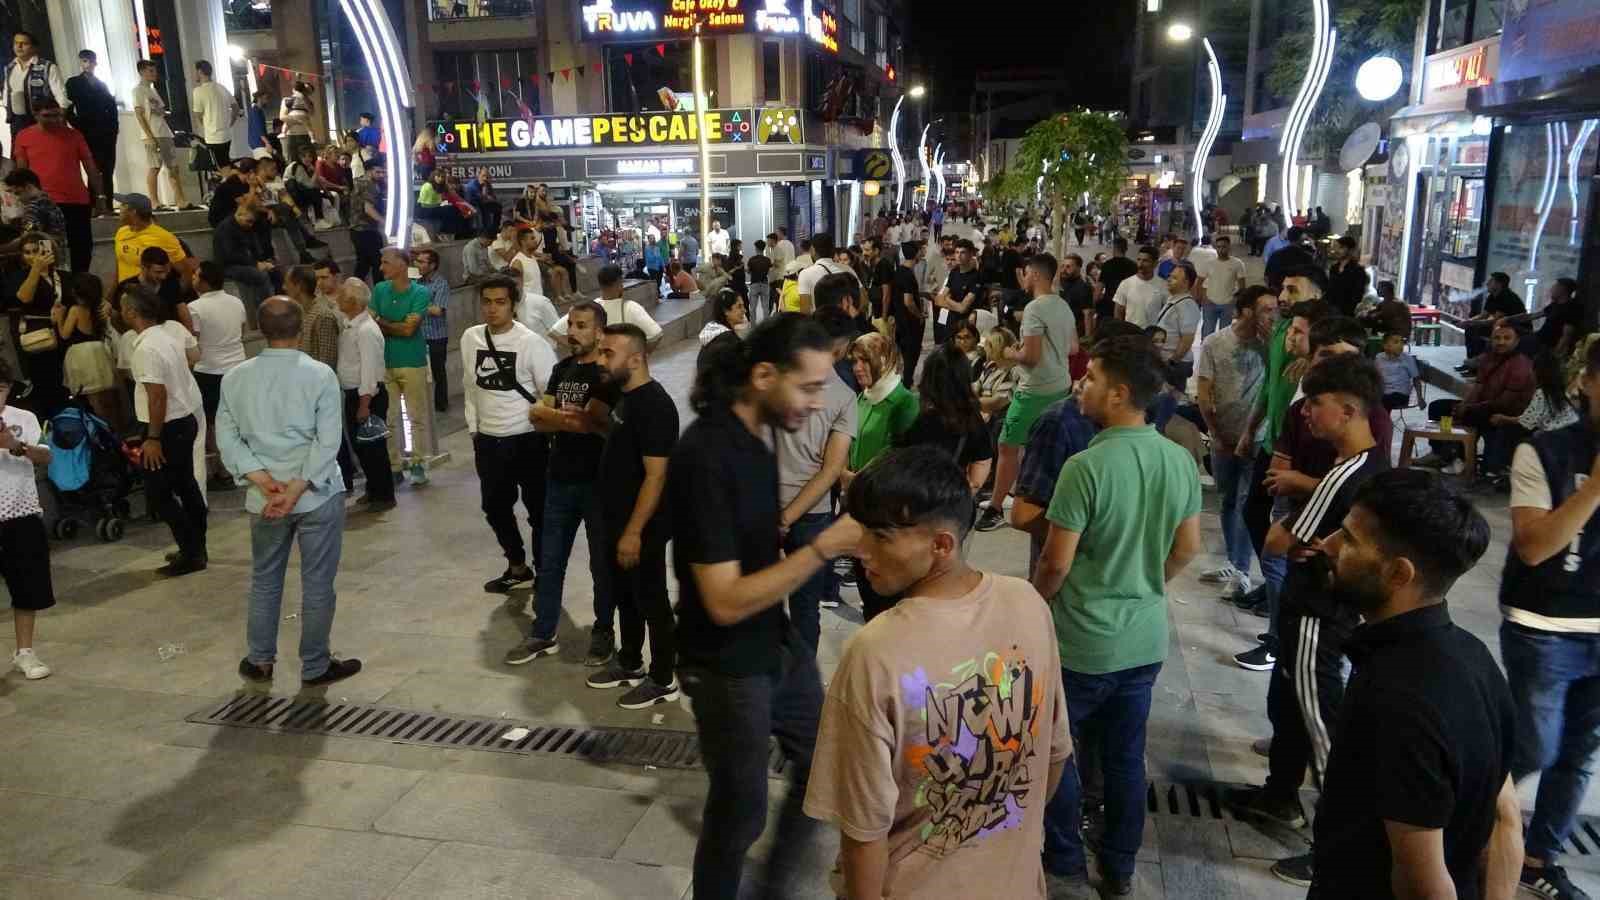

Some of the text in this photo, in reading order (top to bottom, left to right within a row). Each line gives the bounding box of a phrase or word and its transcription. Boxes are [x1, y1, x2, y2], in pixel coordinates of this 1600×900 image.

[582, 6, 656, 32] TRUVA
[709, 12, 744, 25] Salonu
[454, 122, 508, 148] THE
[511, 118, 592, 147] GAME
[592, 115, 646, 143] PES
